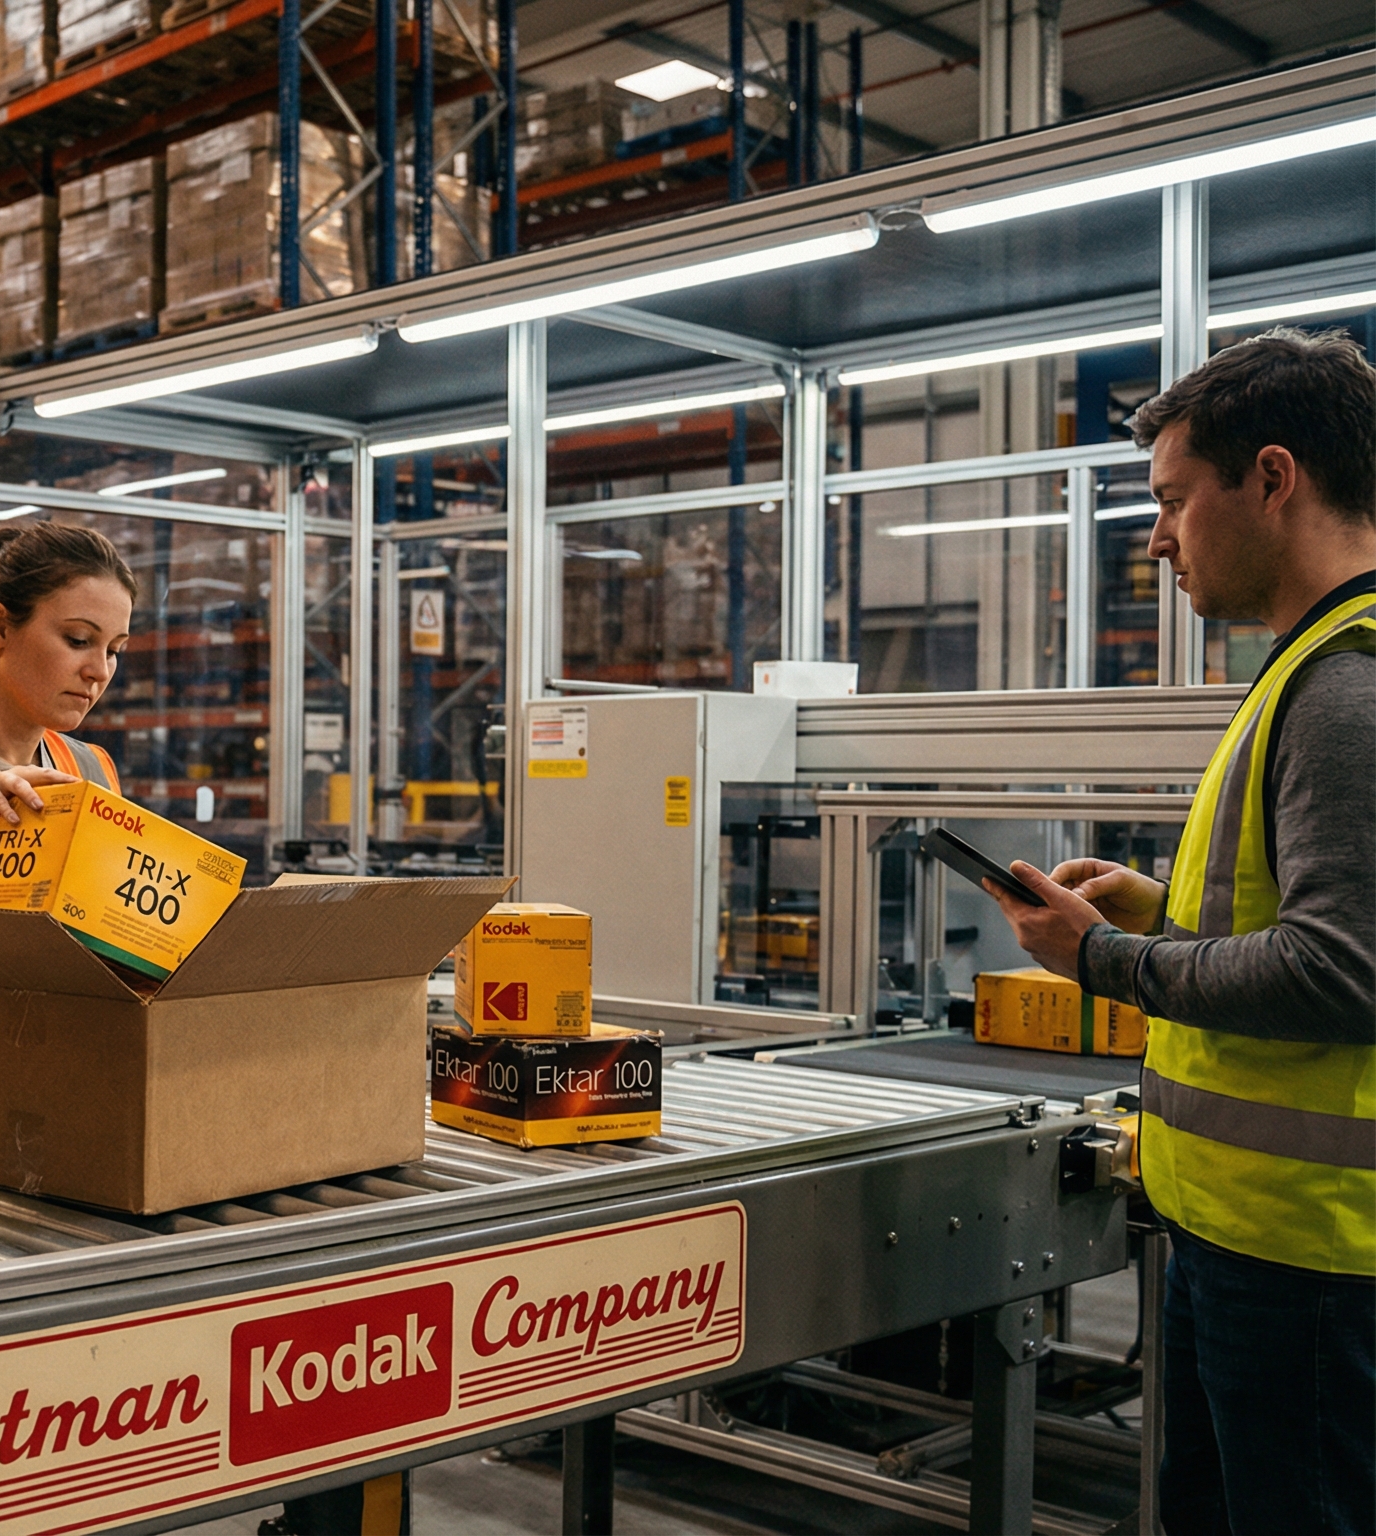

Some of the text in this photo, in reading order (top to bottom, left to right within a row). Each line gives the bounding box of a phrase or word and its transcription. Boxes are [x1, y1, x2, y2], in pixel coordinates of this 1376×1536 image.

[90, 796, 145, 837] Kodak
[126, 846, 192, 896] TRI-X
[114, 878, 180, 925] 400
[482, 921, 531, 936] Kodak
[436, 1049, 519, 1093] Ektar 100
[536, 1059, 653, 1094] Ektar 100
[249, 1313, 438, 1414] Kodak
[471, 1260, 726, 1357] Company
